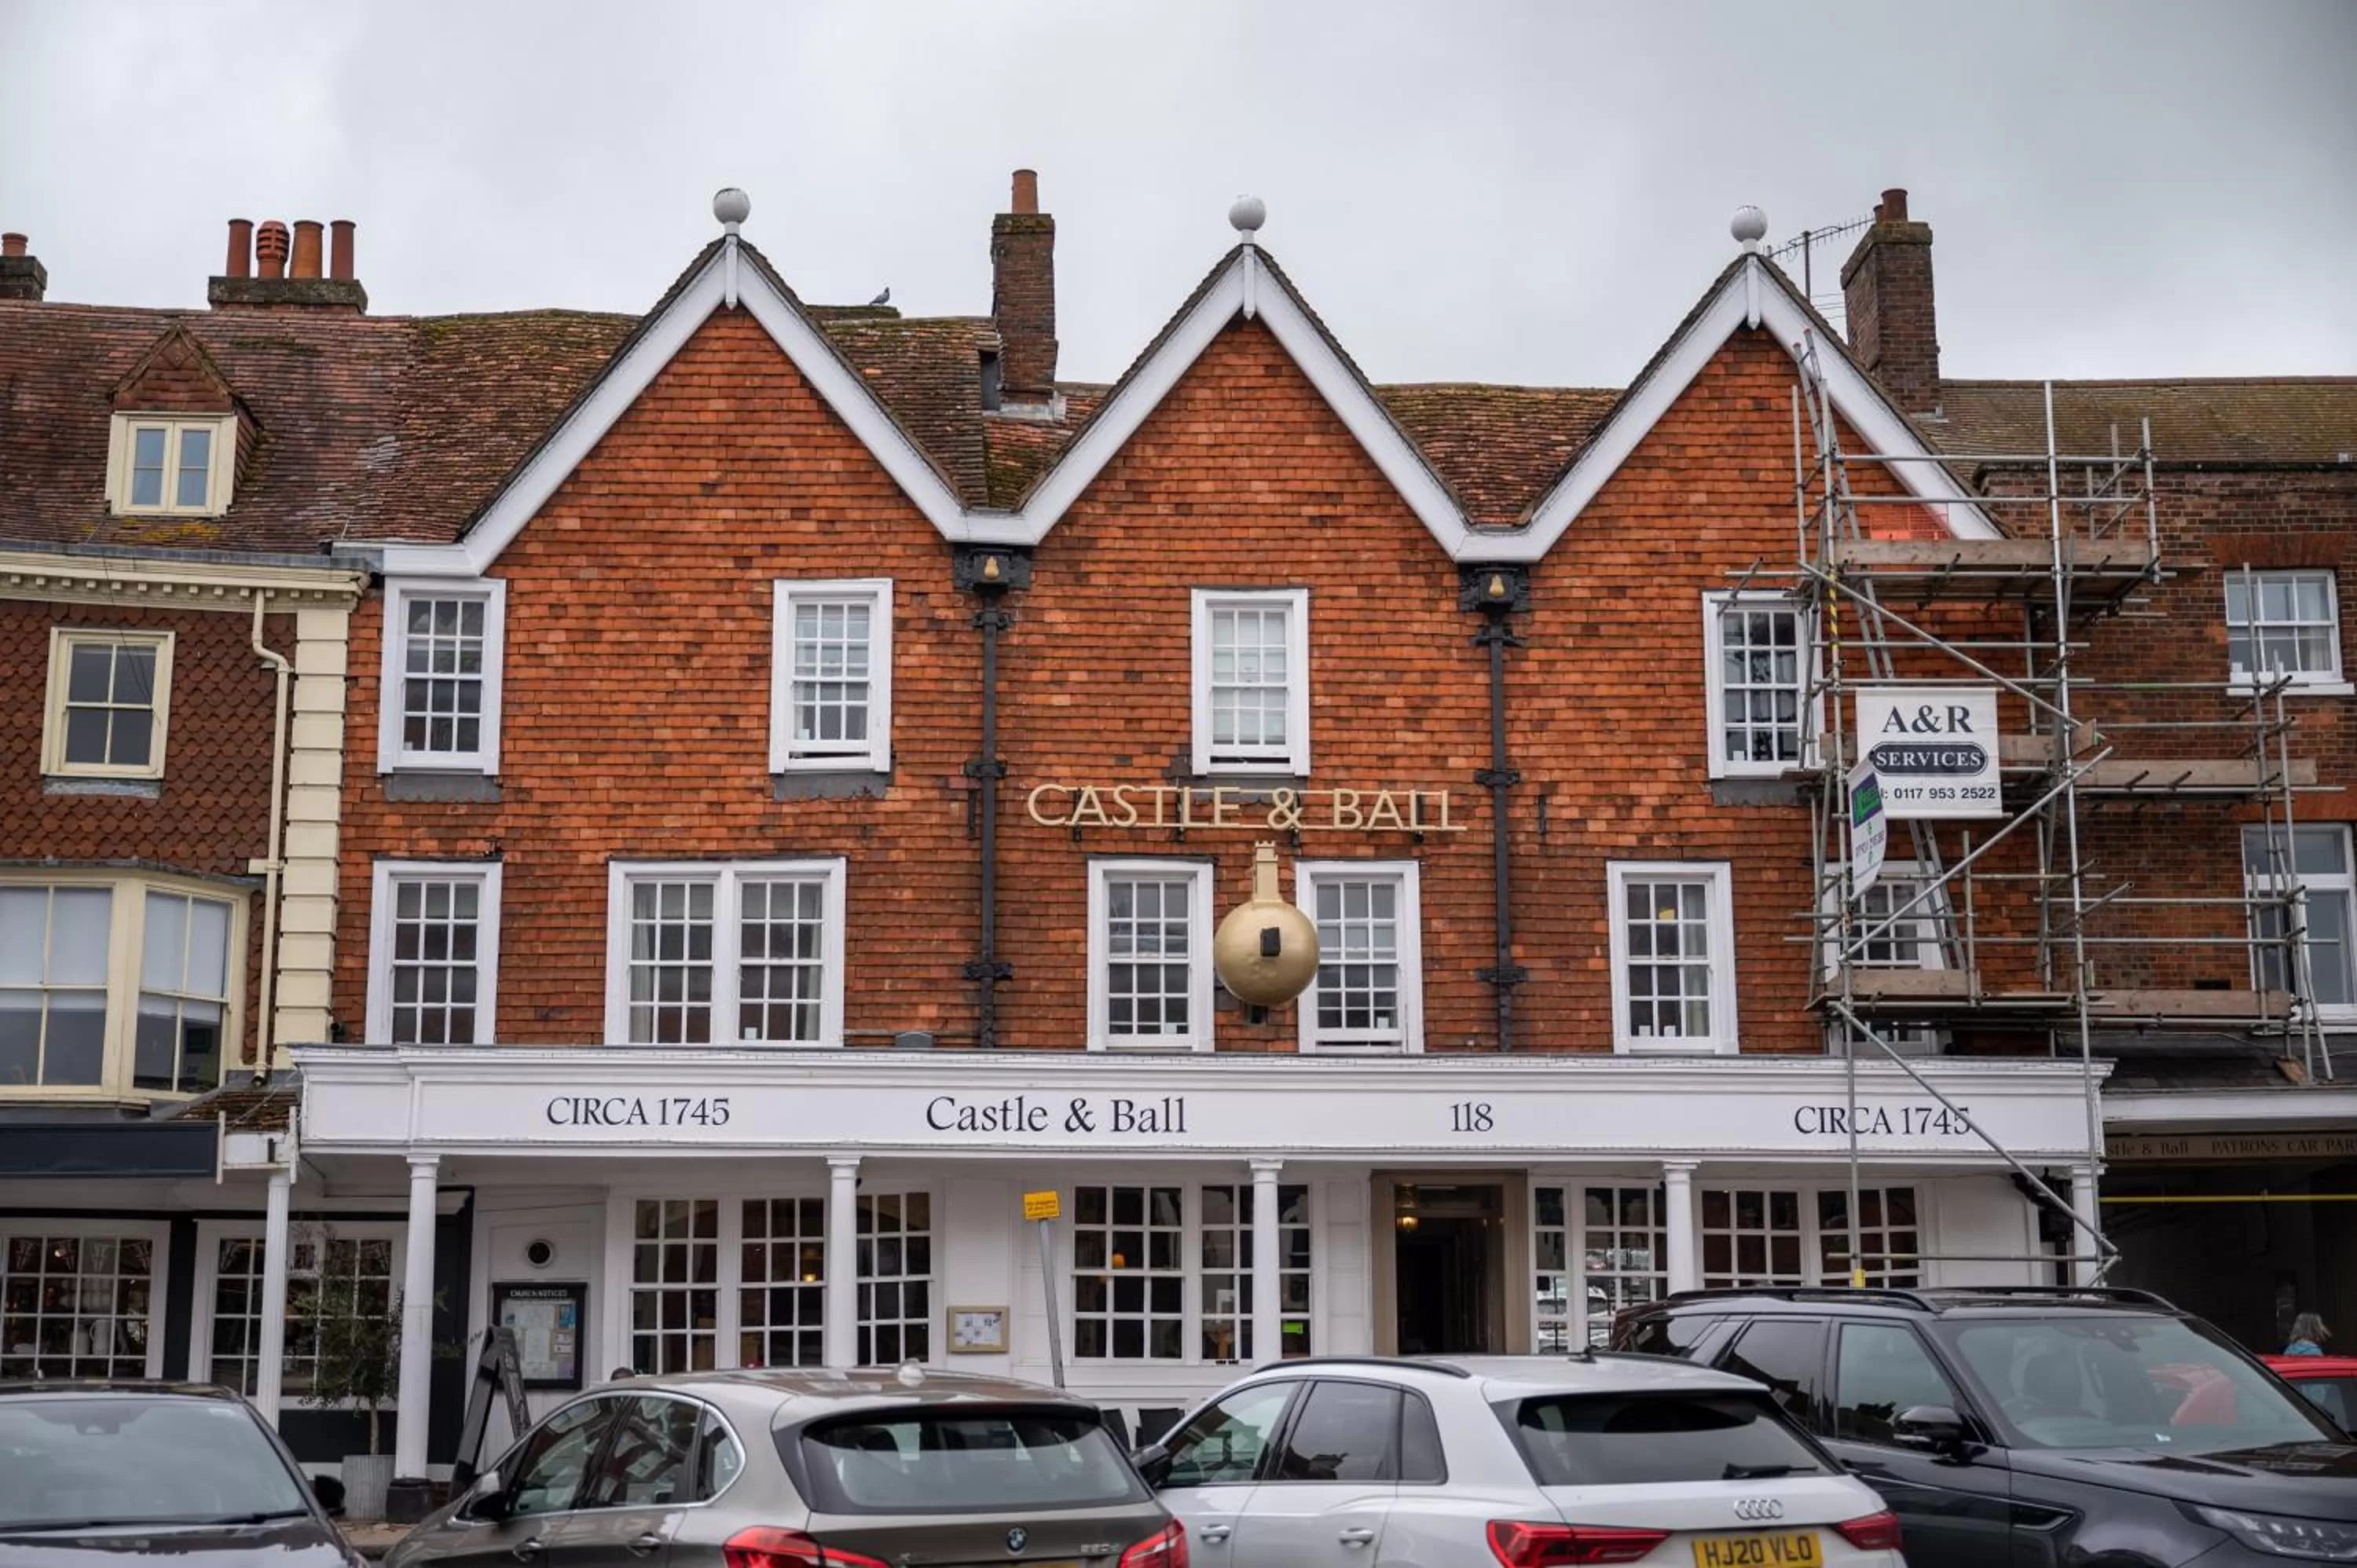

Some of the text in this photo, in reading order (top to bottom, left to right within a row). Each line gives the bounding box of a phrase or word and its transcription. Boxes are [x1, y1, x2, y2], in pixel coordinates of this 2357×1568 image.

[1881, 704, 1974, 733] A&R
[1875, 751, 1981, 767] SERVICES
[1027, 783, 1468, 831] CASTLE & BALL
[1893, 787, 1924, 800] 0117
[1928, 787, 1956, 800] 953
[1960, 787, 1996, 800] 2522
[547, 1097, 730, 1126] CIRCA 1745
[926, 1094, 1188, 1134] Castle & Ball
[1450, 1101, 1494, 1132] 118
[1794, 1105, 1971, 1135] CIRCA 1745
[1703, 1537, 1765, 1567] HJ20
